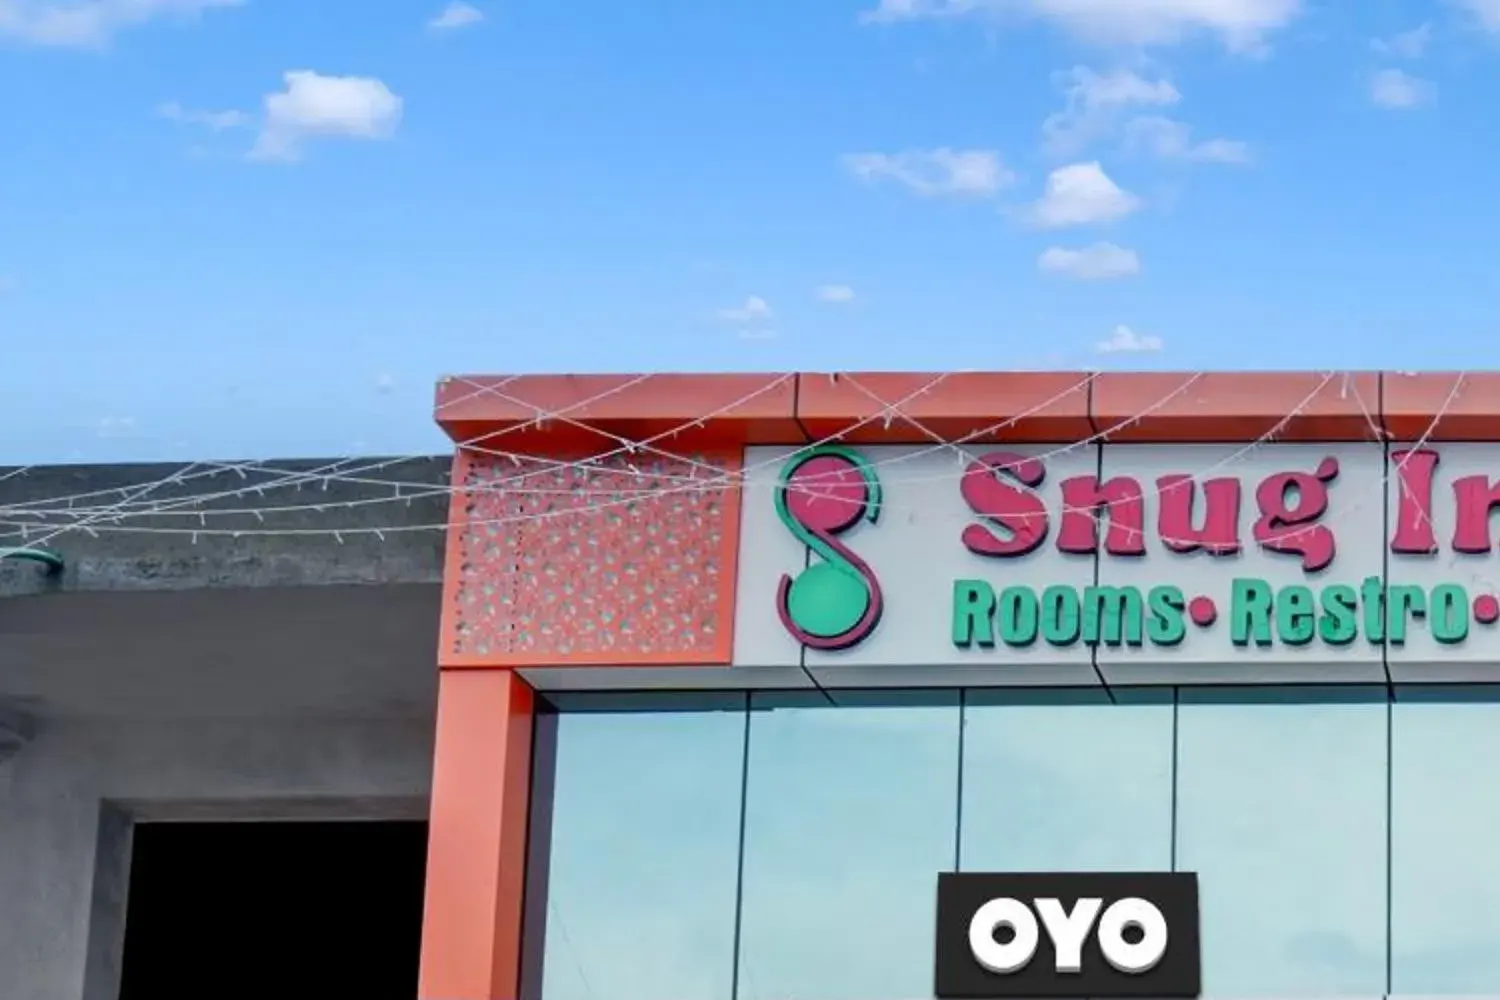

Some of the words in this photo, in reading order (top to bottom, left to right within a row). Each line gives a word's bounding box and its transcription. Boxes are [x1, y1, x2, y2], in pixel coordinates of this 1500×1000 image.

[960, 453, 1338, 572] Snug
[952, 579, 1187, 647] Rooms
[1230, 576, 1470, 646] Restro
[967, 896, 1168, 973] OYO
